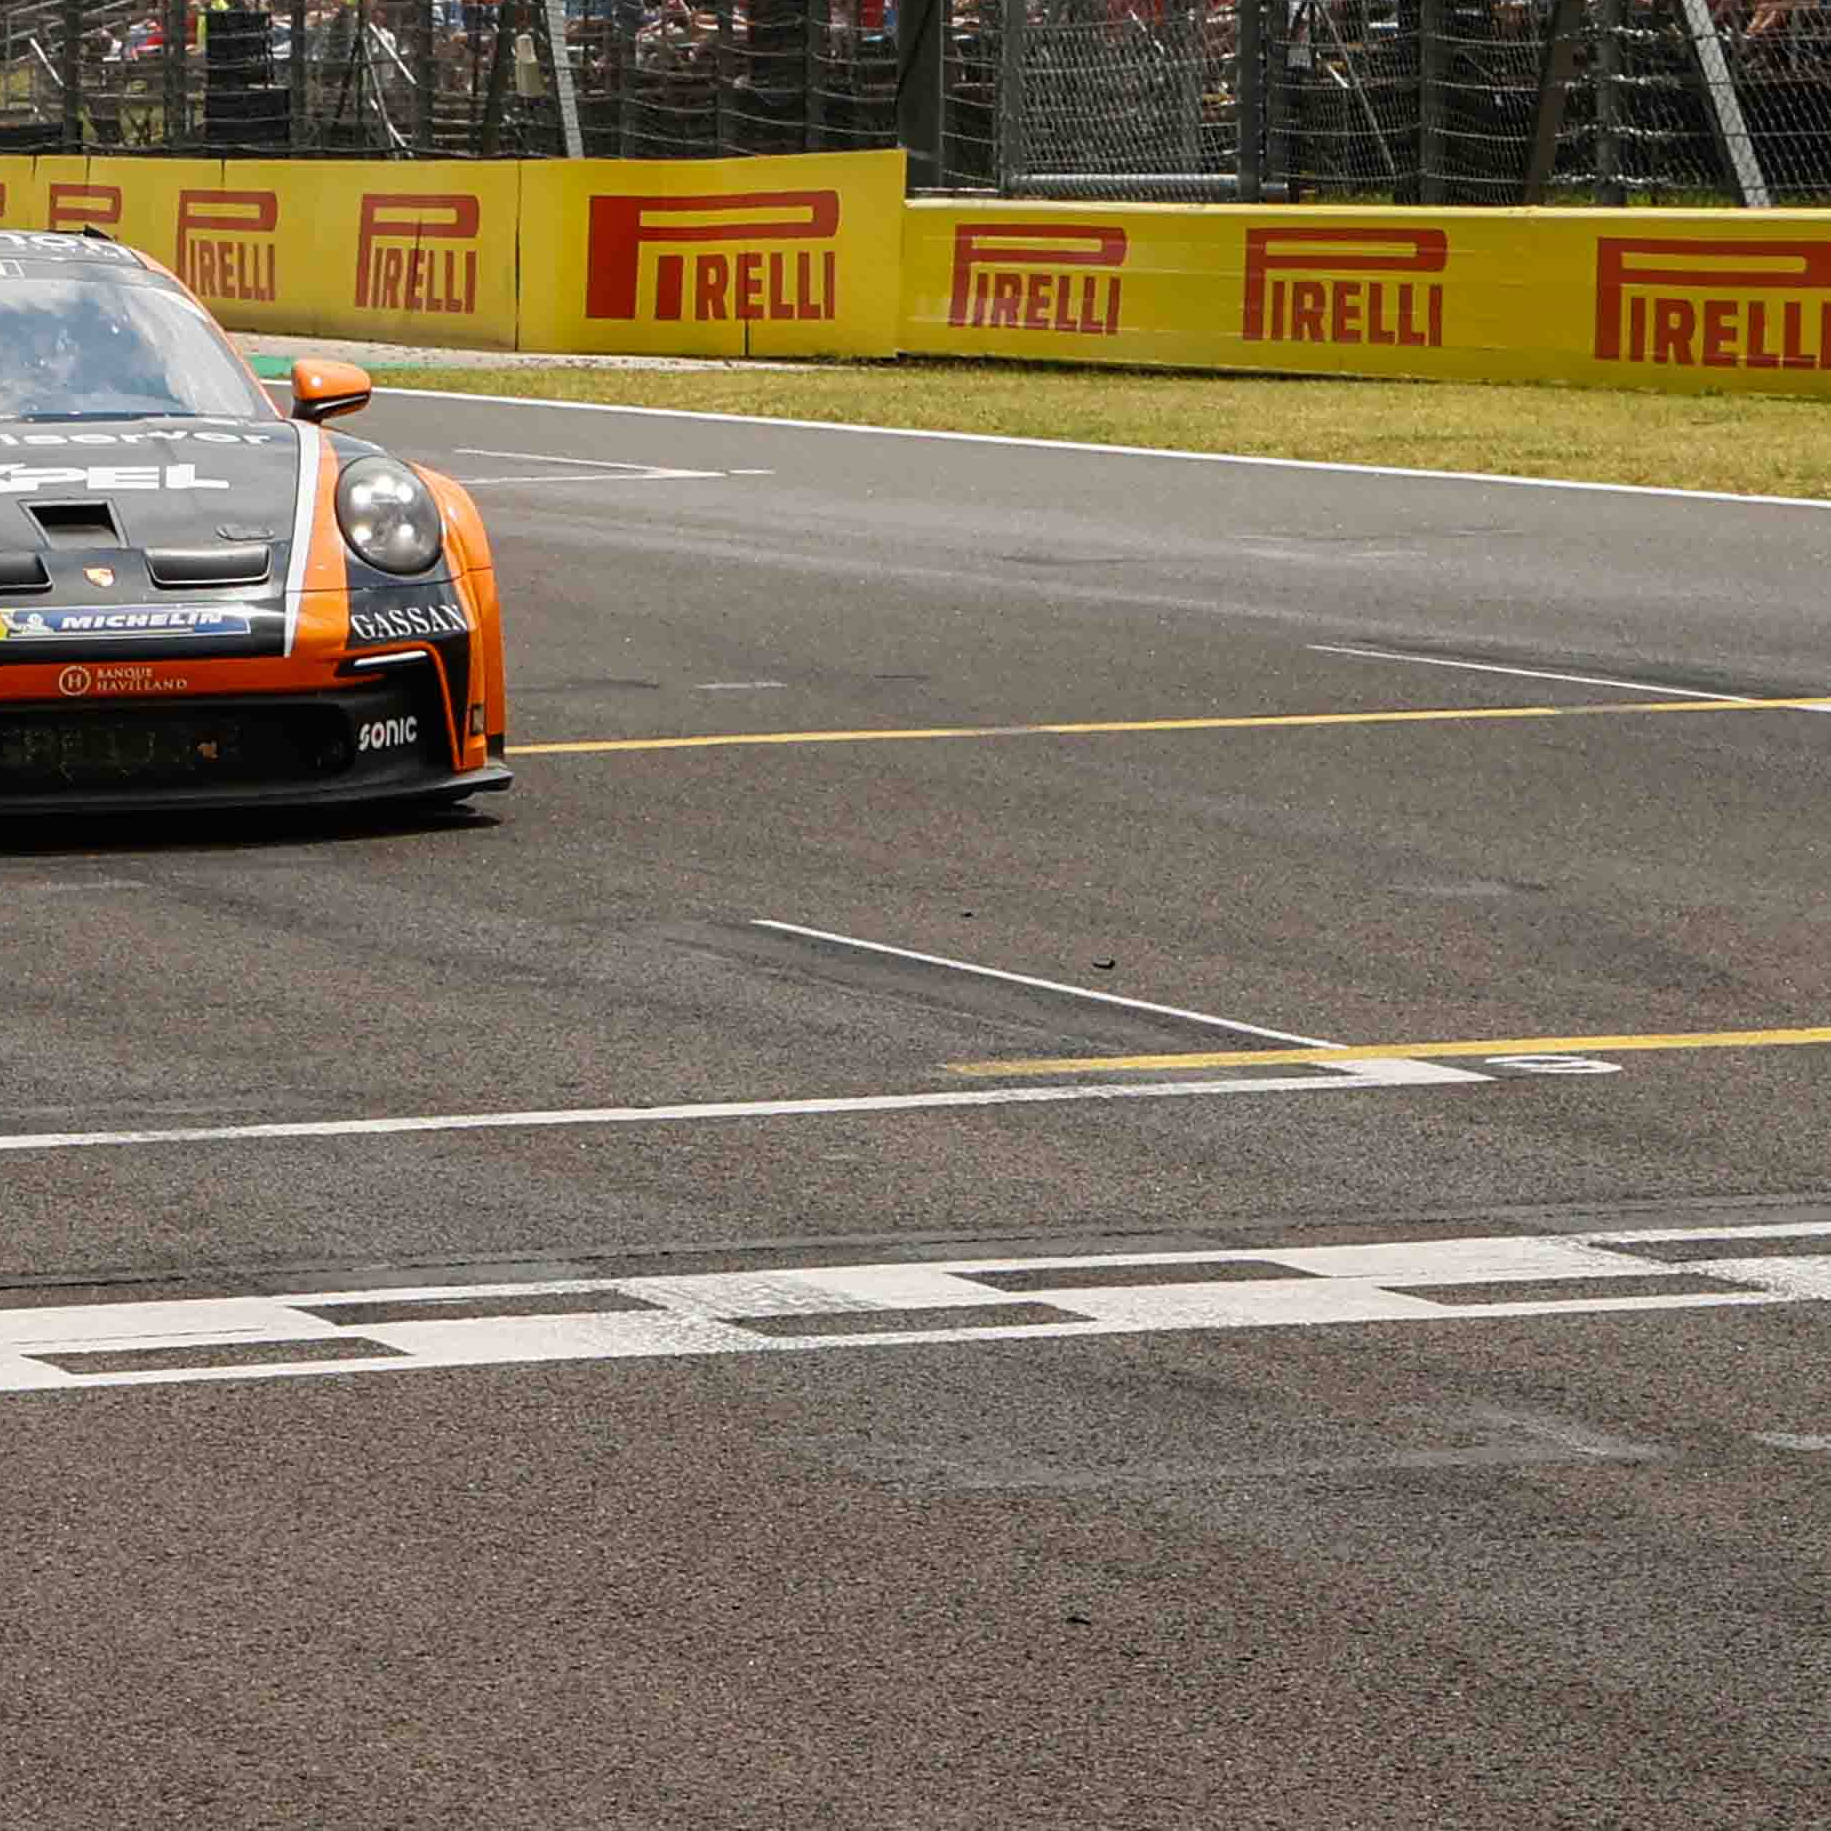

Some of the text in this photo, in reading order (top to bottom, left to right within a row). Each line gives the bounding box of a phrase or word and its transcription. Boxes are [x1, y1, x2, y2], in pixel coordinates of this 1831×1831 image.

[177, 189, 278, 301] PIRELLI
[355, 193, 480, 315] PIRELLI
[585, 189, 841, 321] PIRELLI
[949, 223, 1127, 336] PIRELLI
[1242, 227, 1449, 348] PIRELLI
[1594, 236, 1831, 370] PIRELLI
[61, 609, 223, 630] MICHELIN
[97, 667, 153, 679] BANQUE
[349, 604, 467, 642] GASSAN
[97, 678, 187, 691] HAVILLAND
